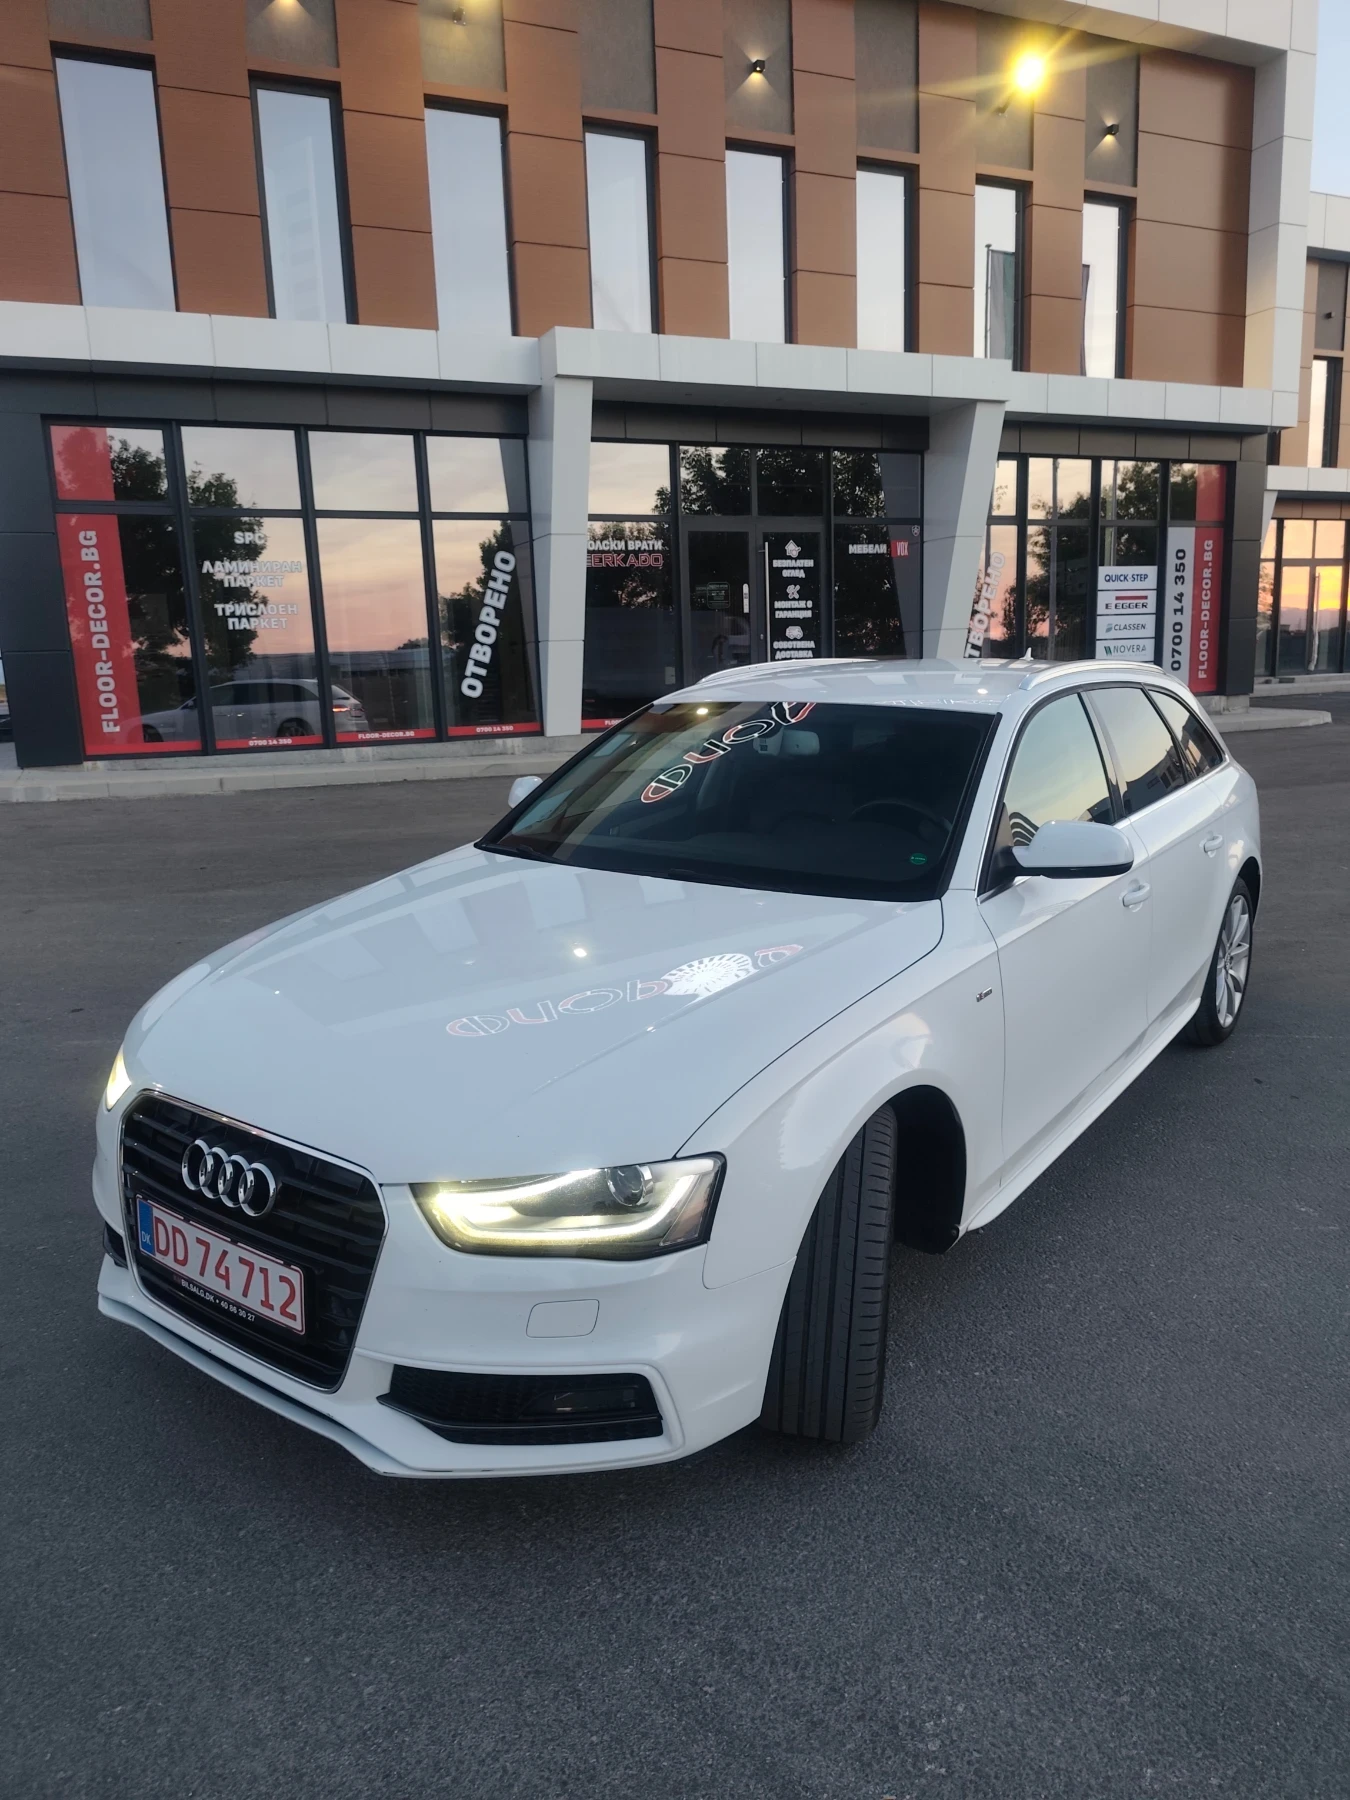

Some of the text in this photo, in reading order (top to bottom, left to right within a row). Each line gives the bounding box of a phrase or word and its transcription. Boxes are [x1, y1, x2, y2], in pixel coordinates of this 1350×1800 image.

[234, 531, 265, 544] SPC
[586, 540, 662, 551] ОЛСКИ ВРАТИ
[848, 541, 908, 556] МЕБЕЛИ VOX
[201, 560, 302, 573] ЛАМИНИРАН
[224, 575, 284, 588] ПАРКЕТ
[214, 603, 298, 617] ТРИСЛОЕН
[774, 601, 806, 609] МОНТАЖ
[964, 551, 1005, 658] ТВОРЕНО
[1114, 602, 1148, 610] EGGER
[1170, 549, 1186, 671] 0700 14 350
[1198, 540, 1213, 679] FLOOR-DECOR.BG
[227, 617, 288, 630] ПАРКЕТ
[460, 550, 516, 698] ОТВОРЕНО
[1113, 623, 1147, 631] CLASSEN
[79, 531, 120, 733] FLOOR-DECOR.BG
[775, 650, 813, 659] ДОСТАВКА
[1113, 644, 1147, 653] NOVERA
[141, 1231, 151, 1245] DK
[154, 1215, 297, 1322] DD 74712
[181, 1279, 215, 1303] BILSALG.DK
